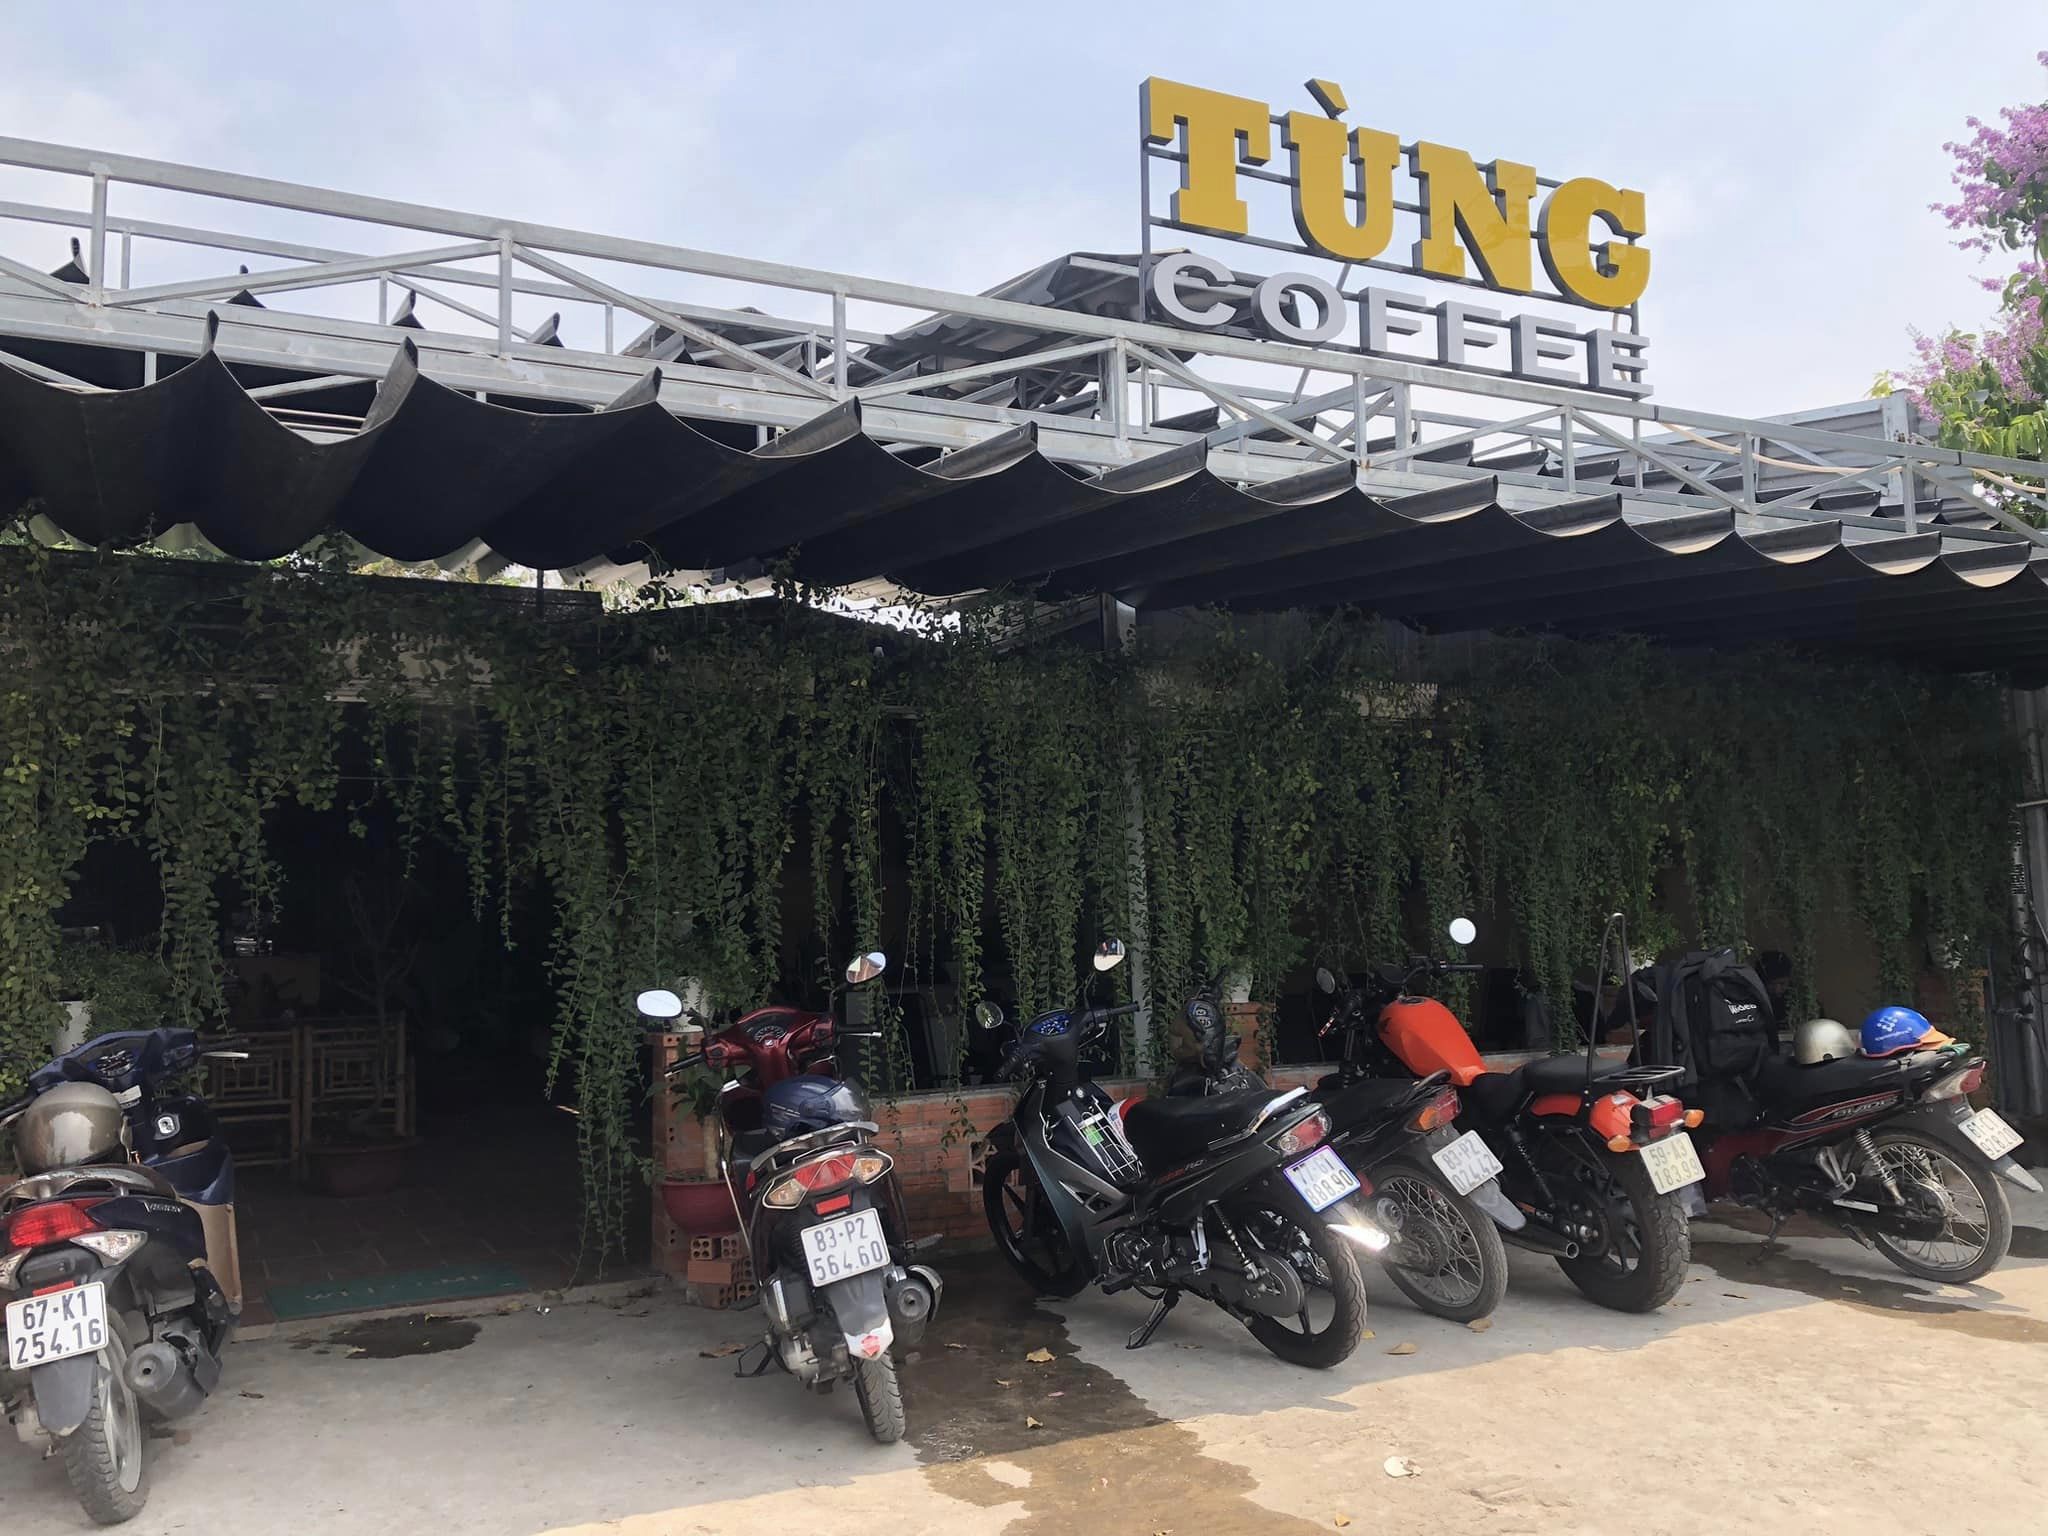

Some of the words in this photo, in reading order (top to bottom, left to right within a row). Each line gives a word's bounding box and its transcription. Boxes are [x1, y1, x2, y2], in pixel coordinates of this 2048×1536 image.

[1139, 77, 1651, 308] TÙNG
[1146, 253, 1655, 400] COFFEE
[15, 1318, 102, 1364] 254.16
